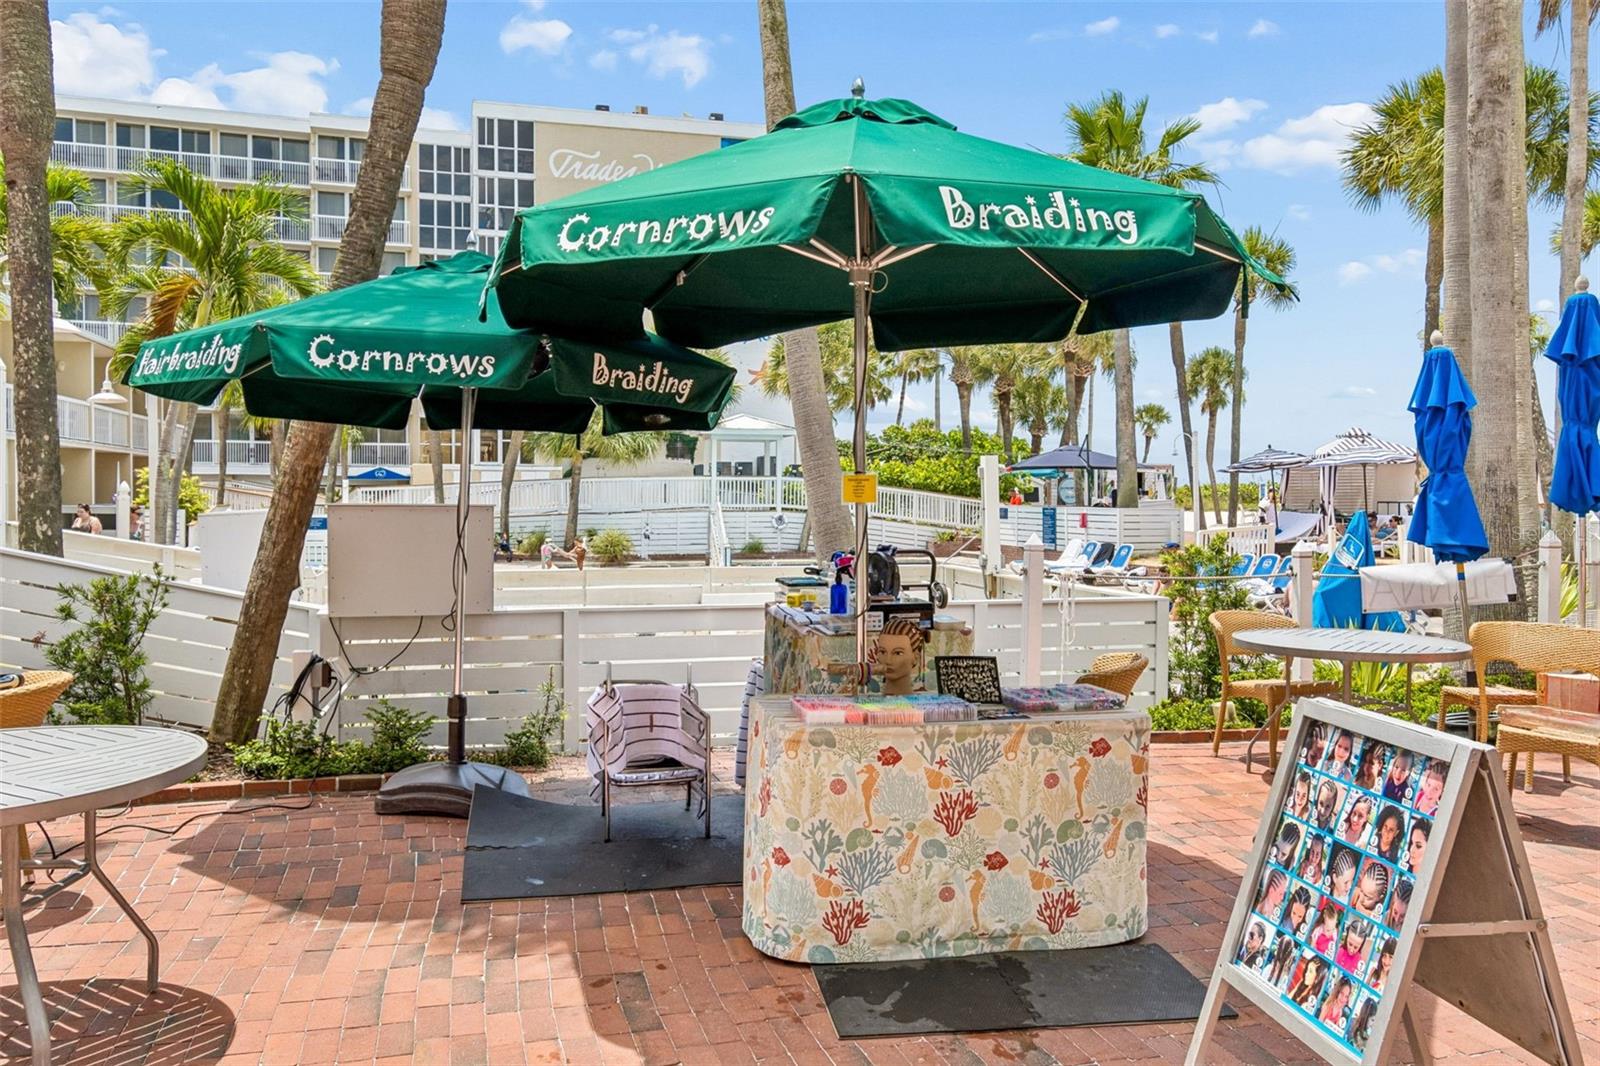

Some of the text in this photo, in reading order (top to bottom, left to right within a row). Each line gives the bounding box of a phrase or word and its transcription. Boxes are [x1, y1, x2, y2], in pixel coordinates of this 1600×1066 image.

[556, 206, 775, 252] Cornrows
[938, 185, 1138, 244] Braiding
[135, 333, 242, 377] Hairbraiding
[307, 333, 496, 378] Cornrows
[592, 352, 694, 404] Braiding
